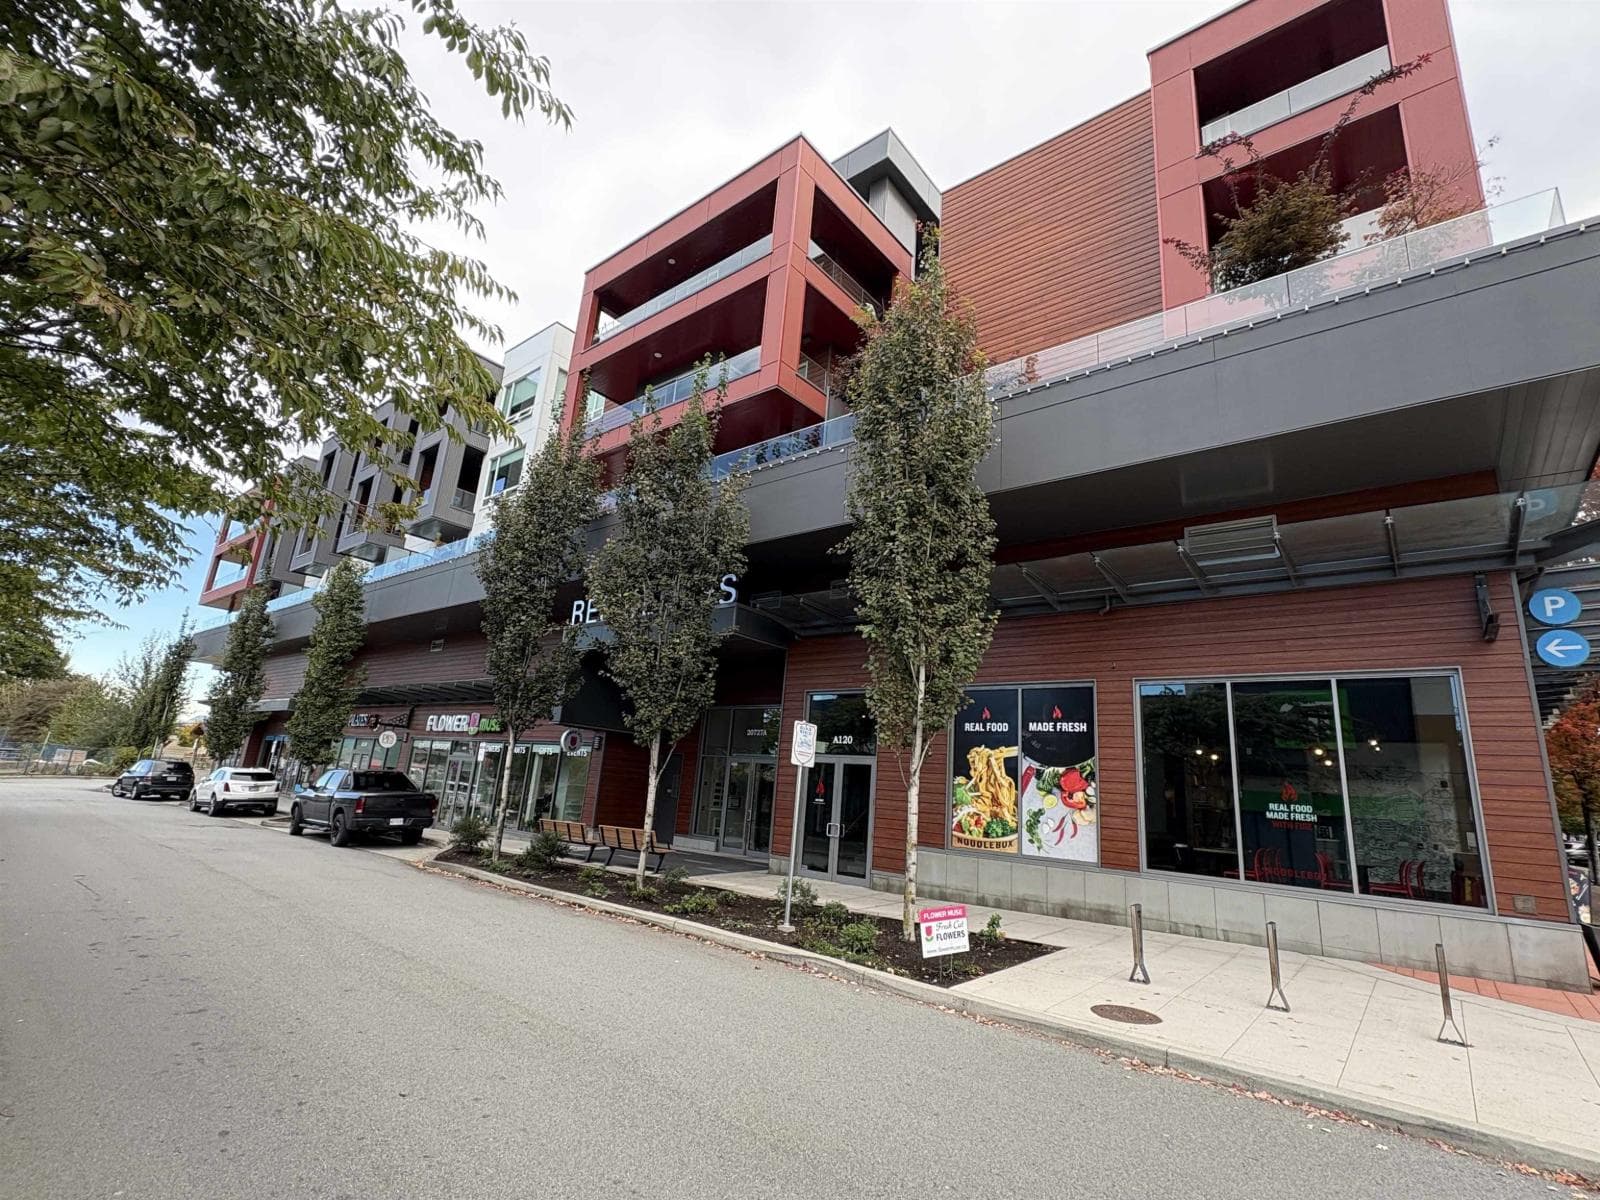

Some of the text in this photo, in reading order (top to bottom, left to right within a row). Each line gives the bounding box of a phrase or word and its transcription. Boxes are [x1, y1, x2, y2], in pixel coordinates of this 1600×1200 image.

[1543, 596, 1565, 617] P
[426, 715, 468, 731] FLOWER
[964, 722, 1009, 732] REAL FOOD
[1028, 722, 1087, 733] MADE FRESH
[832, 735, 853, 744] A120
[1268, 803, 1313, 813] REAL FOOD
[1266, 811, 1318, 822] MADE FRESH
[957, 837, 1013, 849] NOODLEBOX
[923, 908, 963, 920] FLOWER MUSE
[936, 930, 965, 941] FLOWERS
